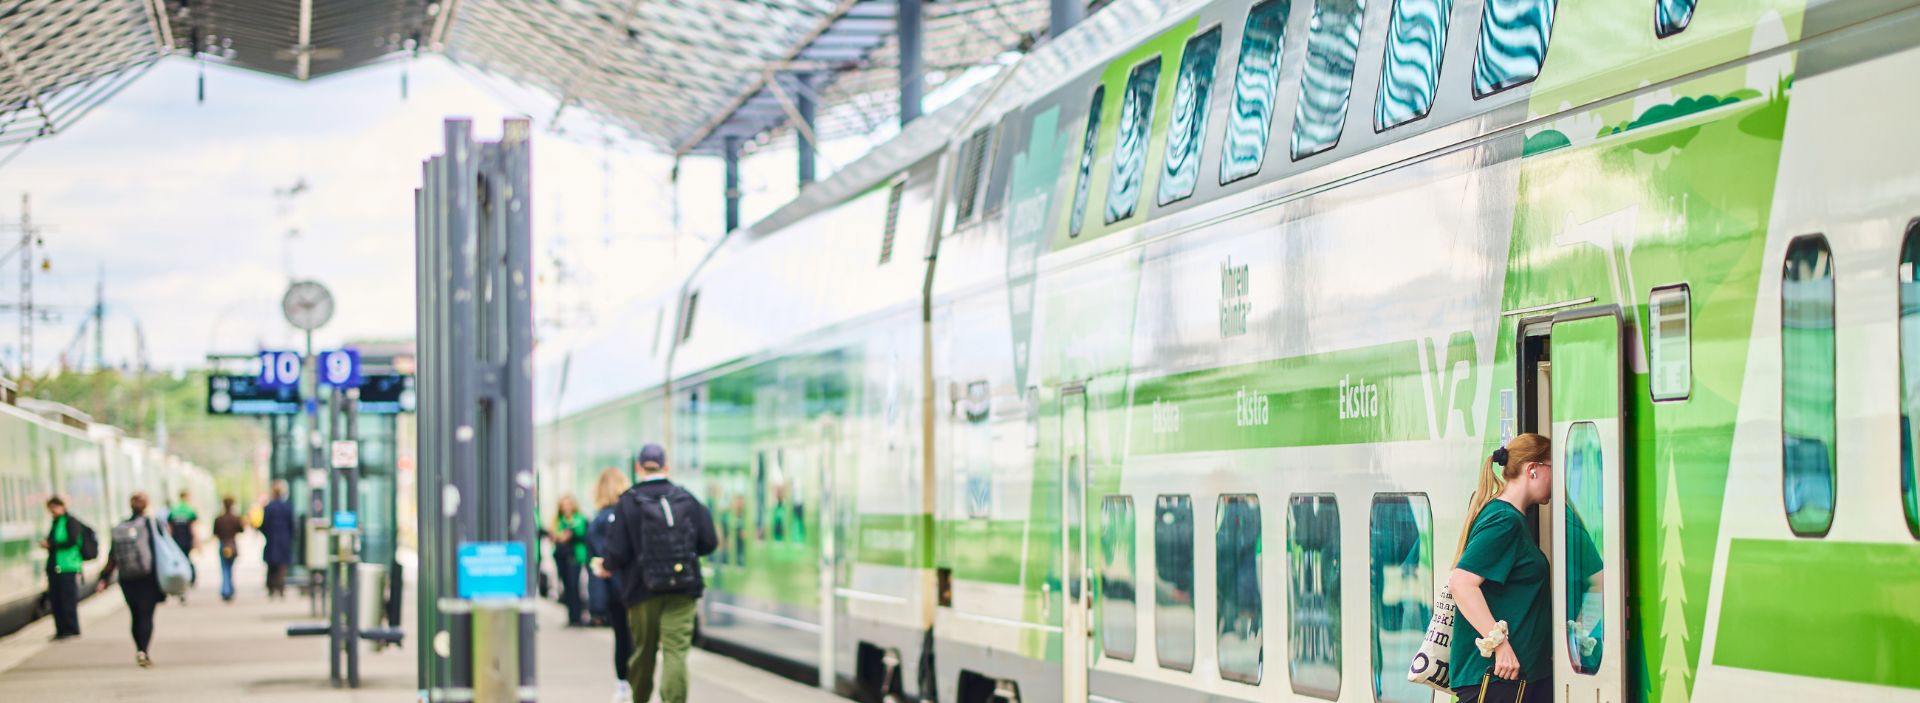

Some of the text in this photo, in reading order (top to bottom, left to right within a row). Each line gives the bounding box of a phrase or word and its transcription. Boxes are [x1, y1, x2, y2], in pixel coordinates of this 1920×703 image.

[262, 351, 300, 384] 10
[326, 351, 351, 384] 9
[1424, 330, 1477, 439] VR
[1152, 396, 1179, 433] Ekstra
[1237, 385, 1269, 426] Ekstra
[1339, 374, 1378, 419] Ekstra
